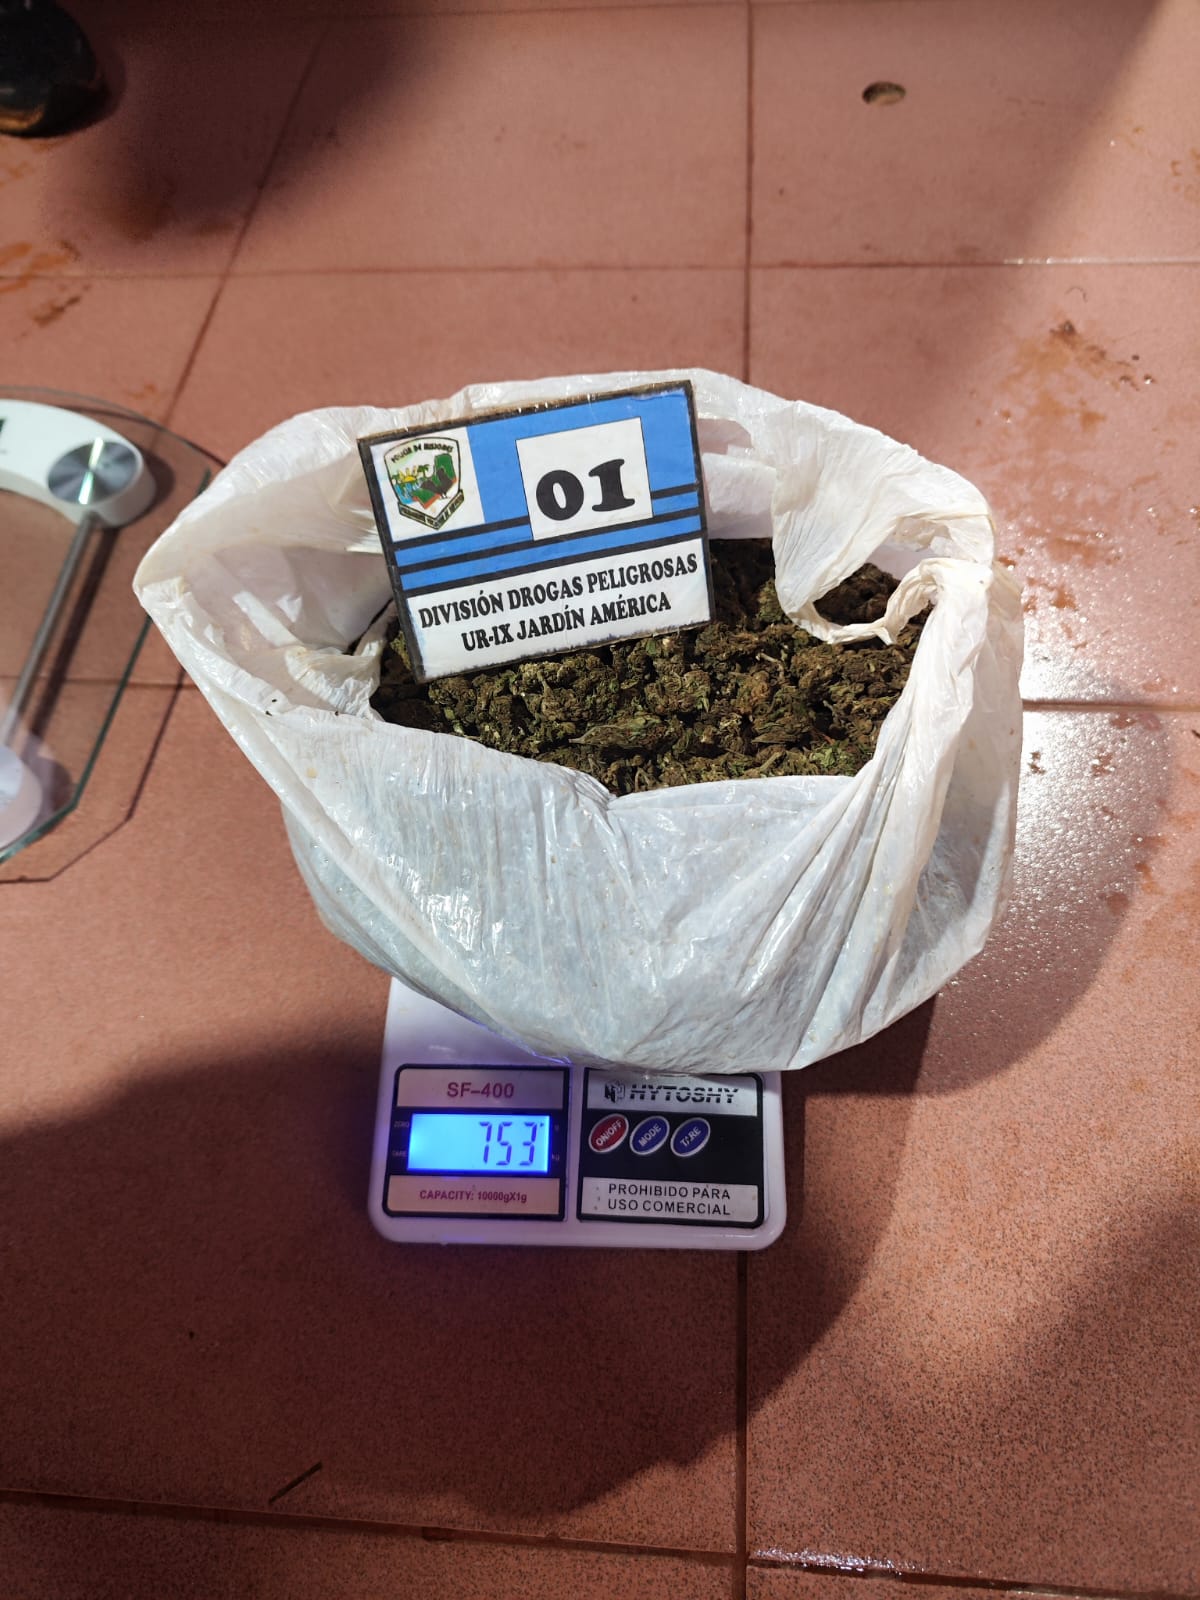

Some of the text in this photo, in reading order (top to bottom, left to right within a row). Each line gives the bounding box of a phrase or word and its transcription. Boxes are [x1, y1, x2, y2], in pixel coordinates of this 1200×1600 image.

[535, 458, 636, 521] 01
[418, 553, 698, 628] DIVISIÓN DROGAS PELIGROSAS
[461, 591, 671, 651] UR-IX JARDÍN AMÉRICA
[446, 1082, 515, 1098] SF-400
[629, 1084, 738, 1104] HYTOSHY
[479, 1121, 538, 1166] 753
[595, 1119, 622, 1147] ON/OFF
[638, 1123, 662, 1147] MODE
[680, 1126, 701, 1147] TARE
[419, 1190, 474, 1201] CAPACITY:
[608, 1183, 731, 1200] PROHIBIDO PARA
[607, 1198, 731, 1216] USO COMERCIAL
